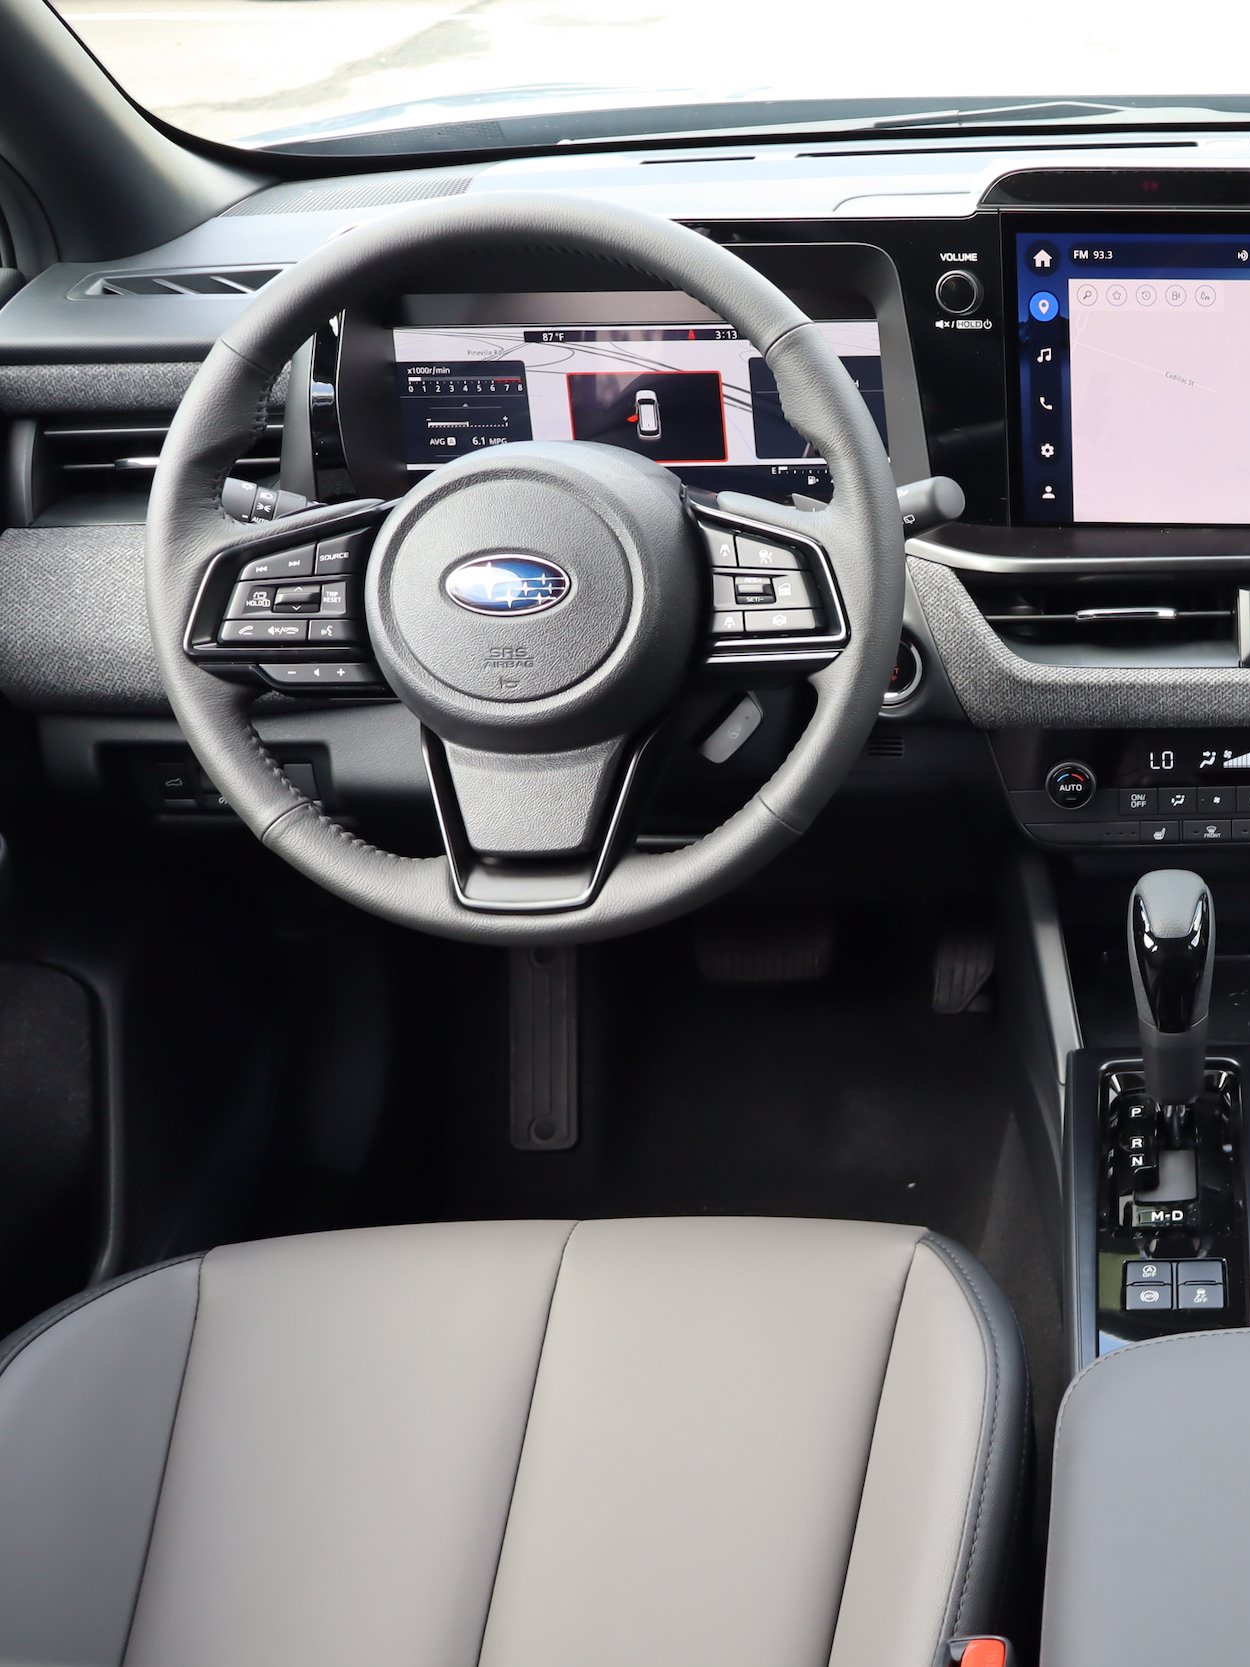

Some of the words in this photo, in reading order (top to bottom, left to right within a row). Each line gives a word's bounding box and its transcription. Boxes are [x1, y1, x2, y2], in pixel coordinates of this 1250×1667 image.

[940, 253, 977, 261] VOLUME
[1074, 250, 1088, 259] FM
[1093, 250, 1112, 259] 93.3
[715, 330, 737, 339] 3:13
[407, 366, 450, 375] x1000r/min
[490, 384, 495, 392] 6
[505, 384, 510, 392] 7
[518, 384, 523, 392] 8
[430, 438, 445, 446] AVG
[472, 437, 486, 445] 6.1
[320, 552, 349, 561] SOURCE
[489, 648, 528, 658] SRS
[482, 660, 534, 668] AIRBAG
[1150, 751, 1174, 769] LO
[1059, 784, 1082, 792] AUTO
[1131, 1108, 1142, 1116] P
[1132, 1139, 1143, 1147] R
[1131, 1157, 1143, 1165] N
